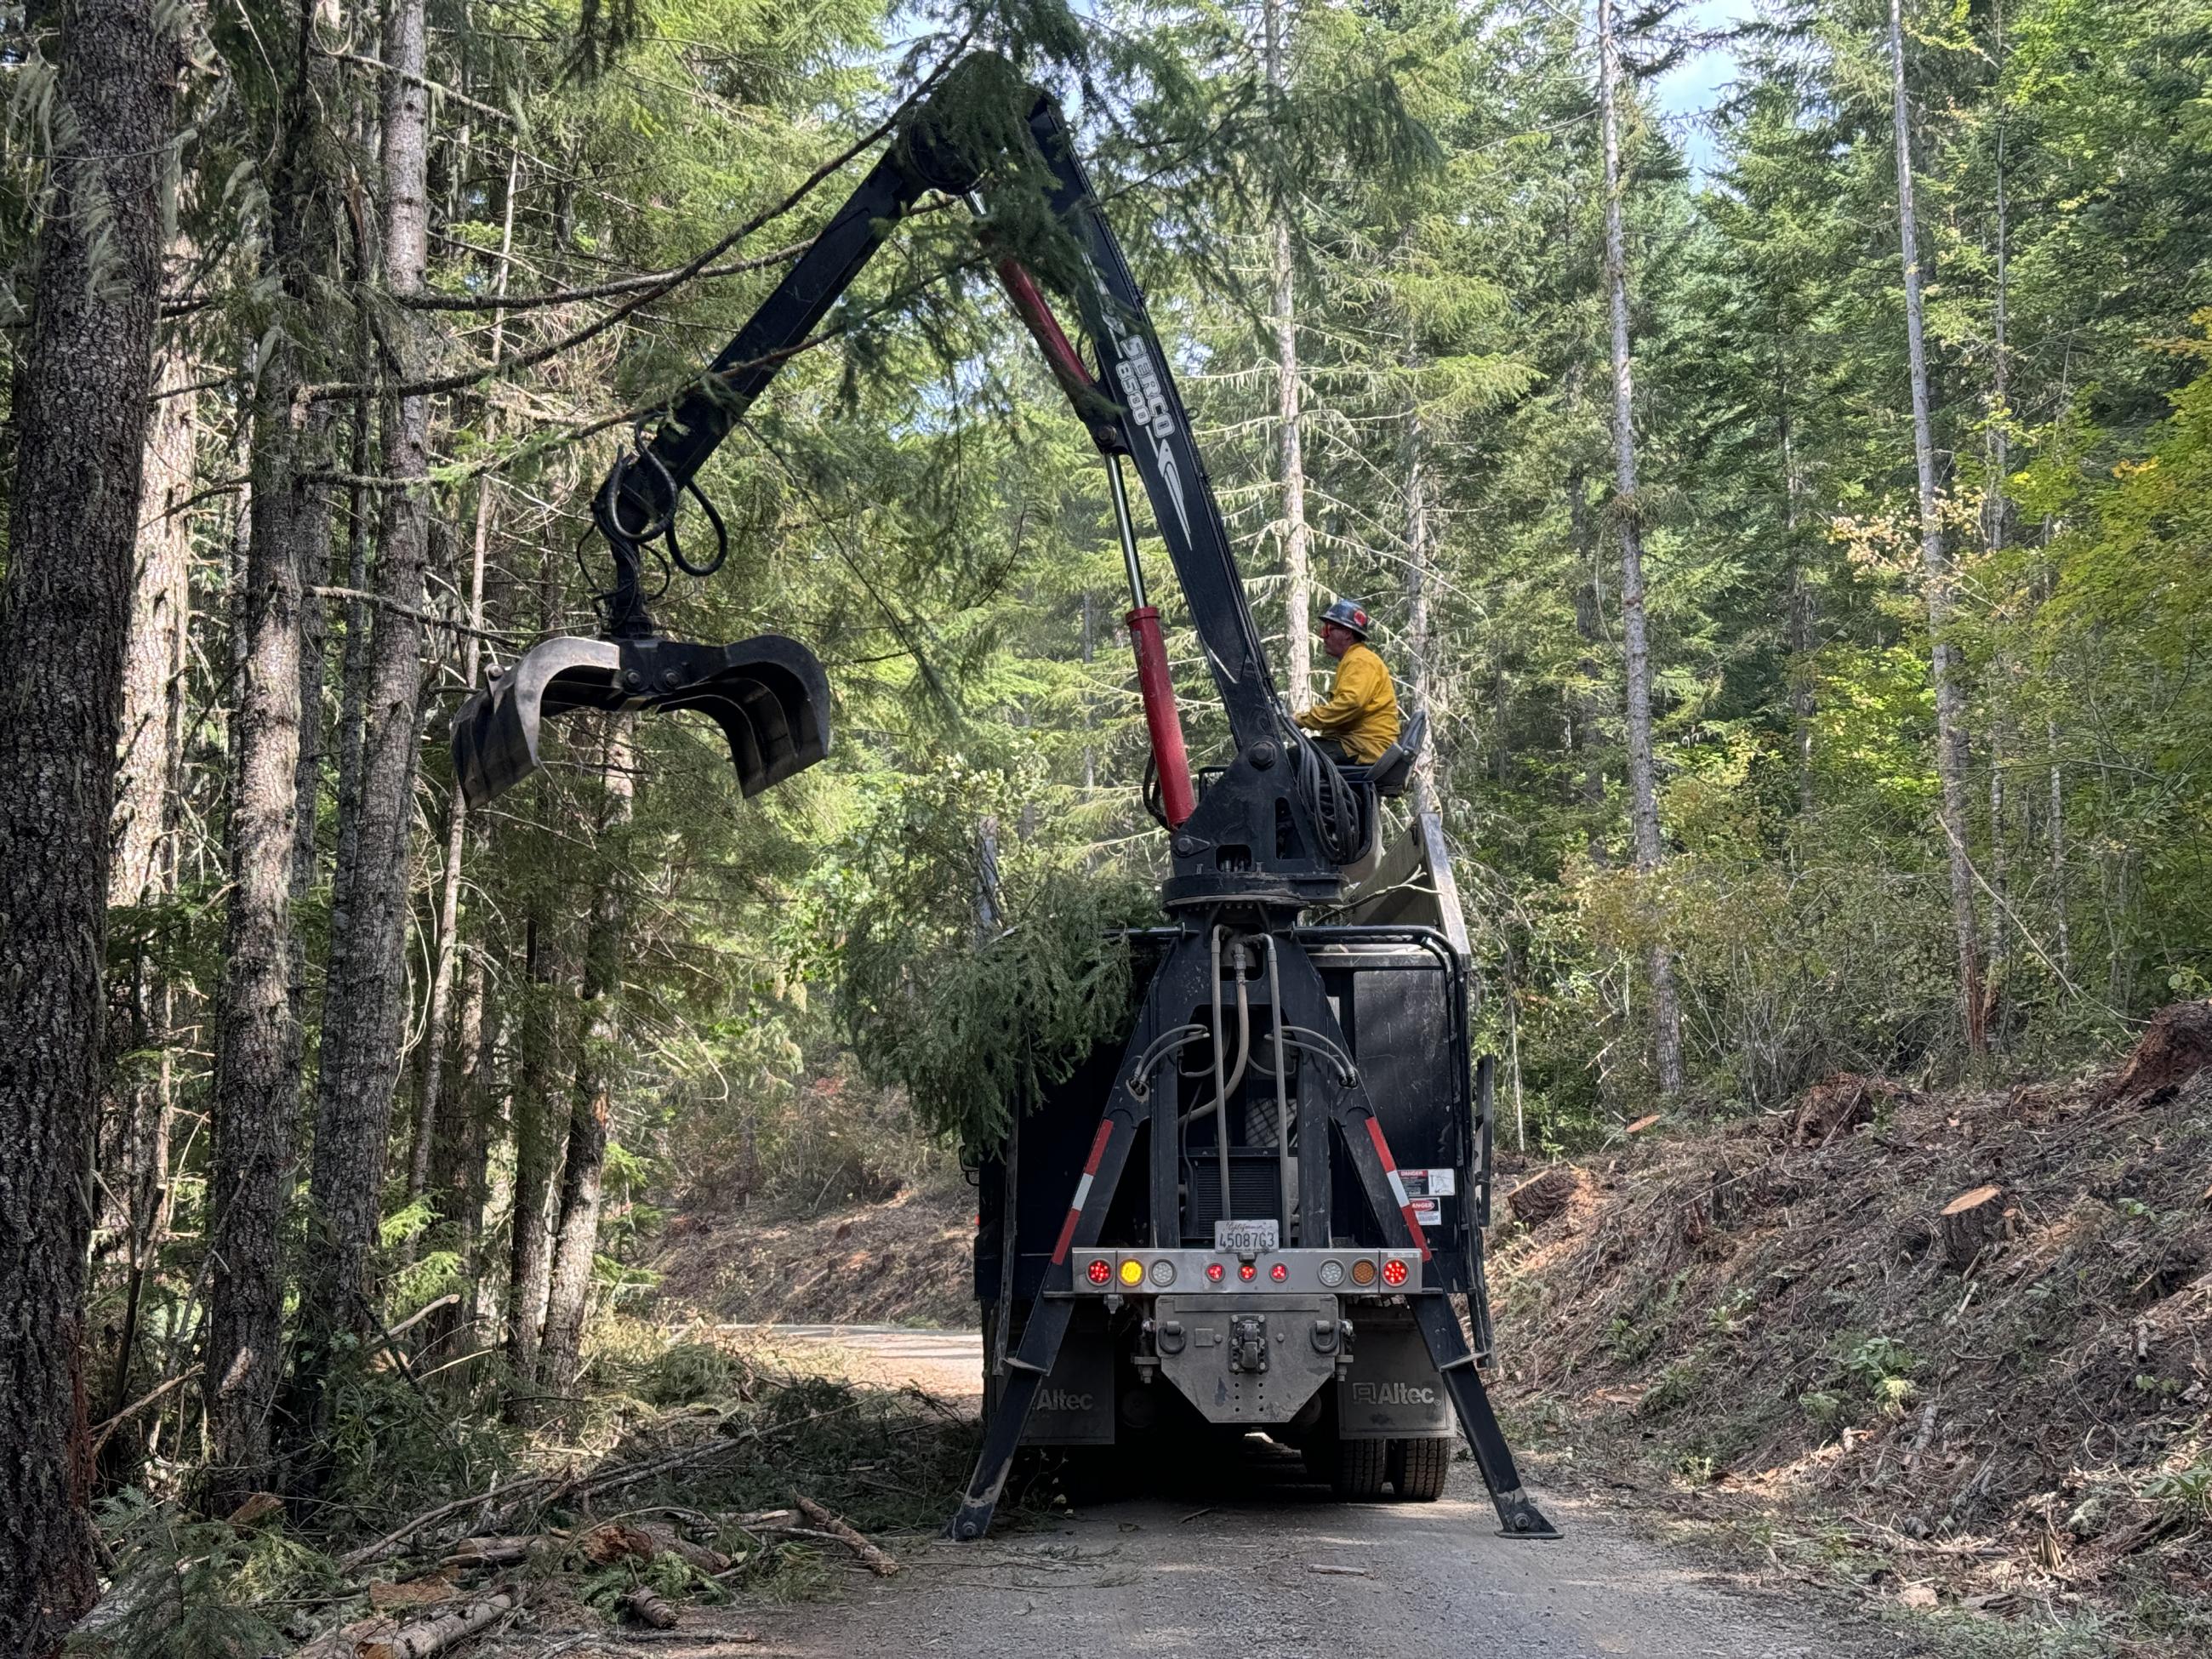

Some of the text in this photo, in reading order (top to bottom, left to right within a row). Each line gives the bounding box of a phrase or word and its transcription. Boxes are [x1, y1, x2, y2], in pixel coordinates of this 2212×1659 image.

[1115, 360, 1151, 425] 8500
[1120, 334, 1175, 439] SERCO
[1219, 1232, 1274, 1248] 45087G3
[1037, 1388, 1094, 1411] Altec
[1377, 1382, 1435, 1405] Altec
